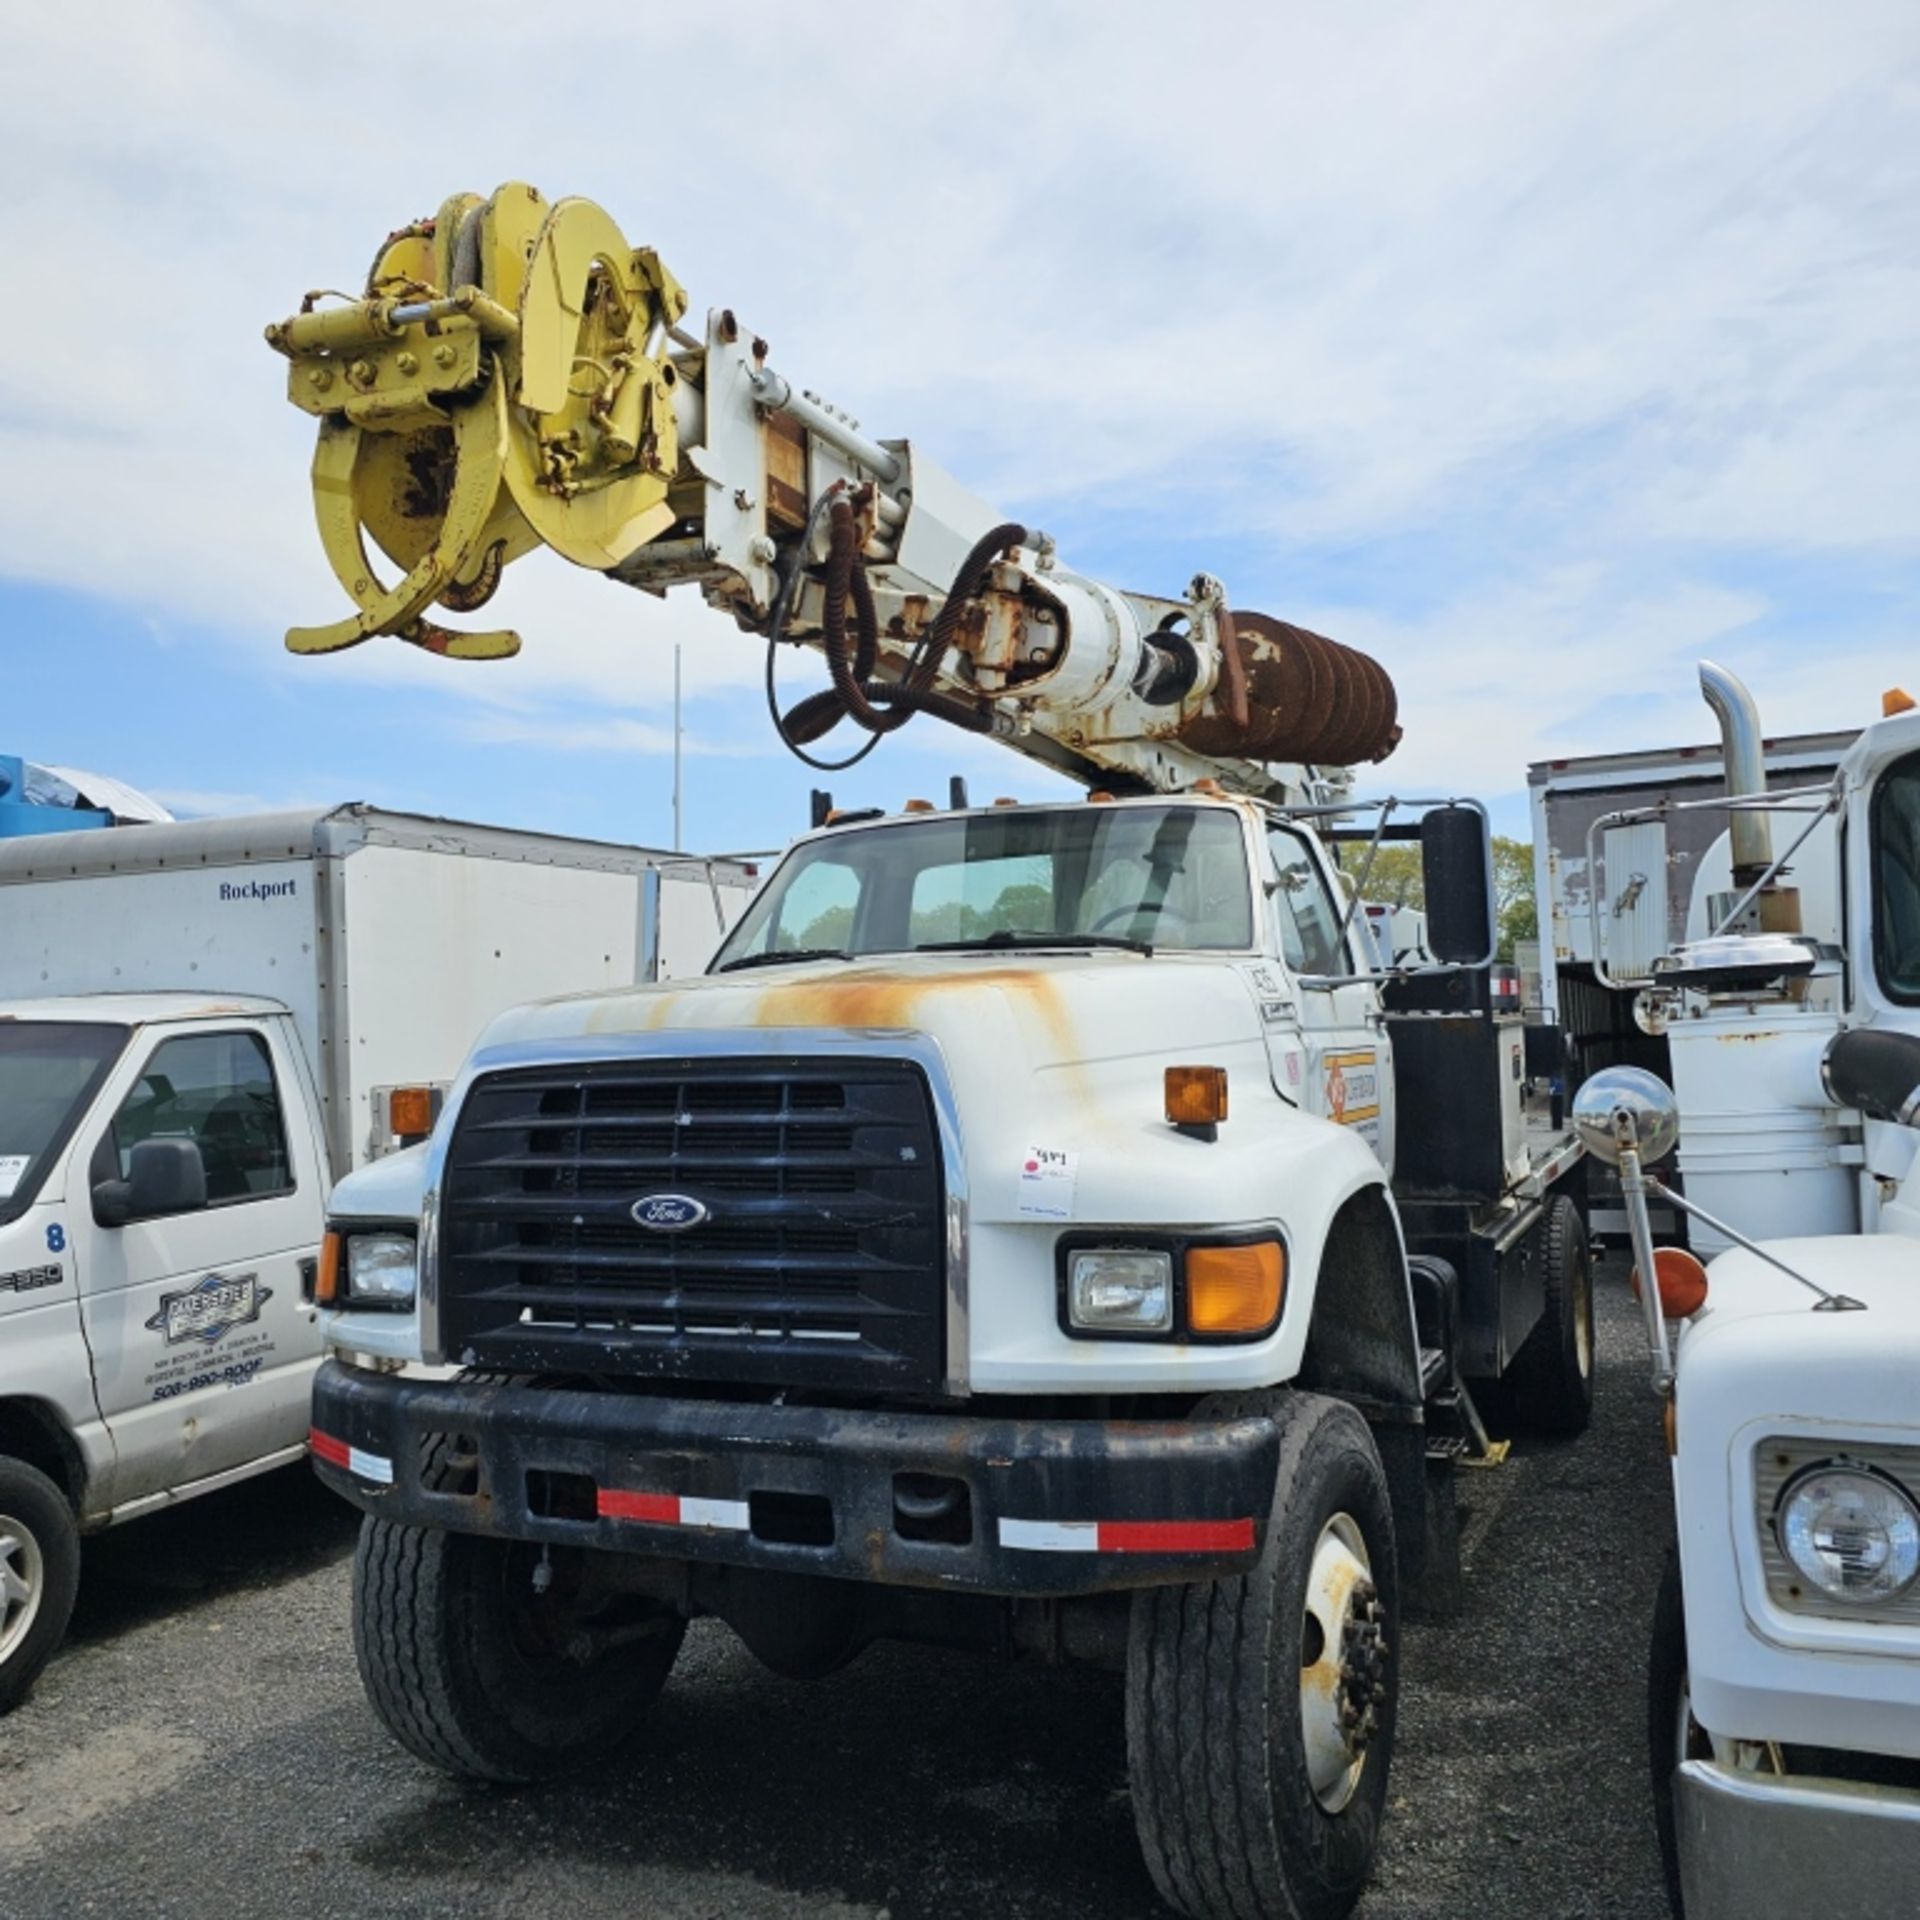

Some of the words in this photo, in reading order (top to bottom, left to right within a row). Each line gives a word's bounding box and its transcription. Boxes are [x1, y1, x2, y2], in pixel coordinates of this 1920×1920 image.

[219, 879, 296, 901] Rockport
[646, 1201, 686, 1221] Ford
[46, 1223, 65, 1252] 8
[152, 1356, 263, 1401] 508-990-ROOF
